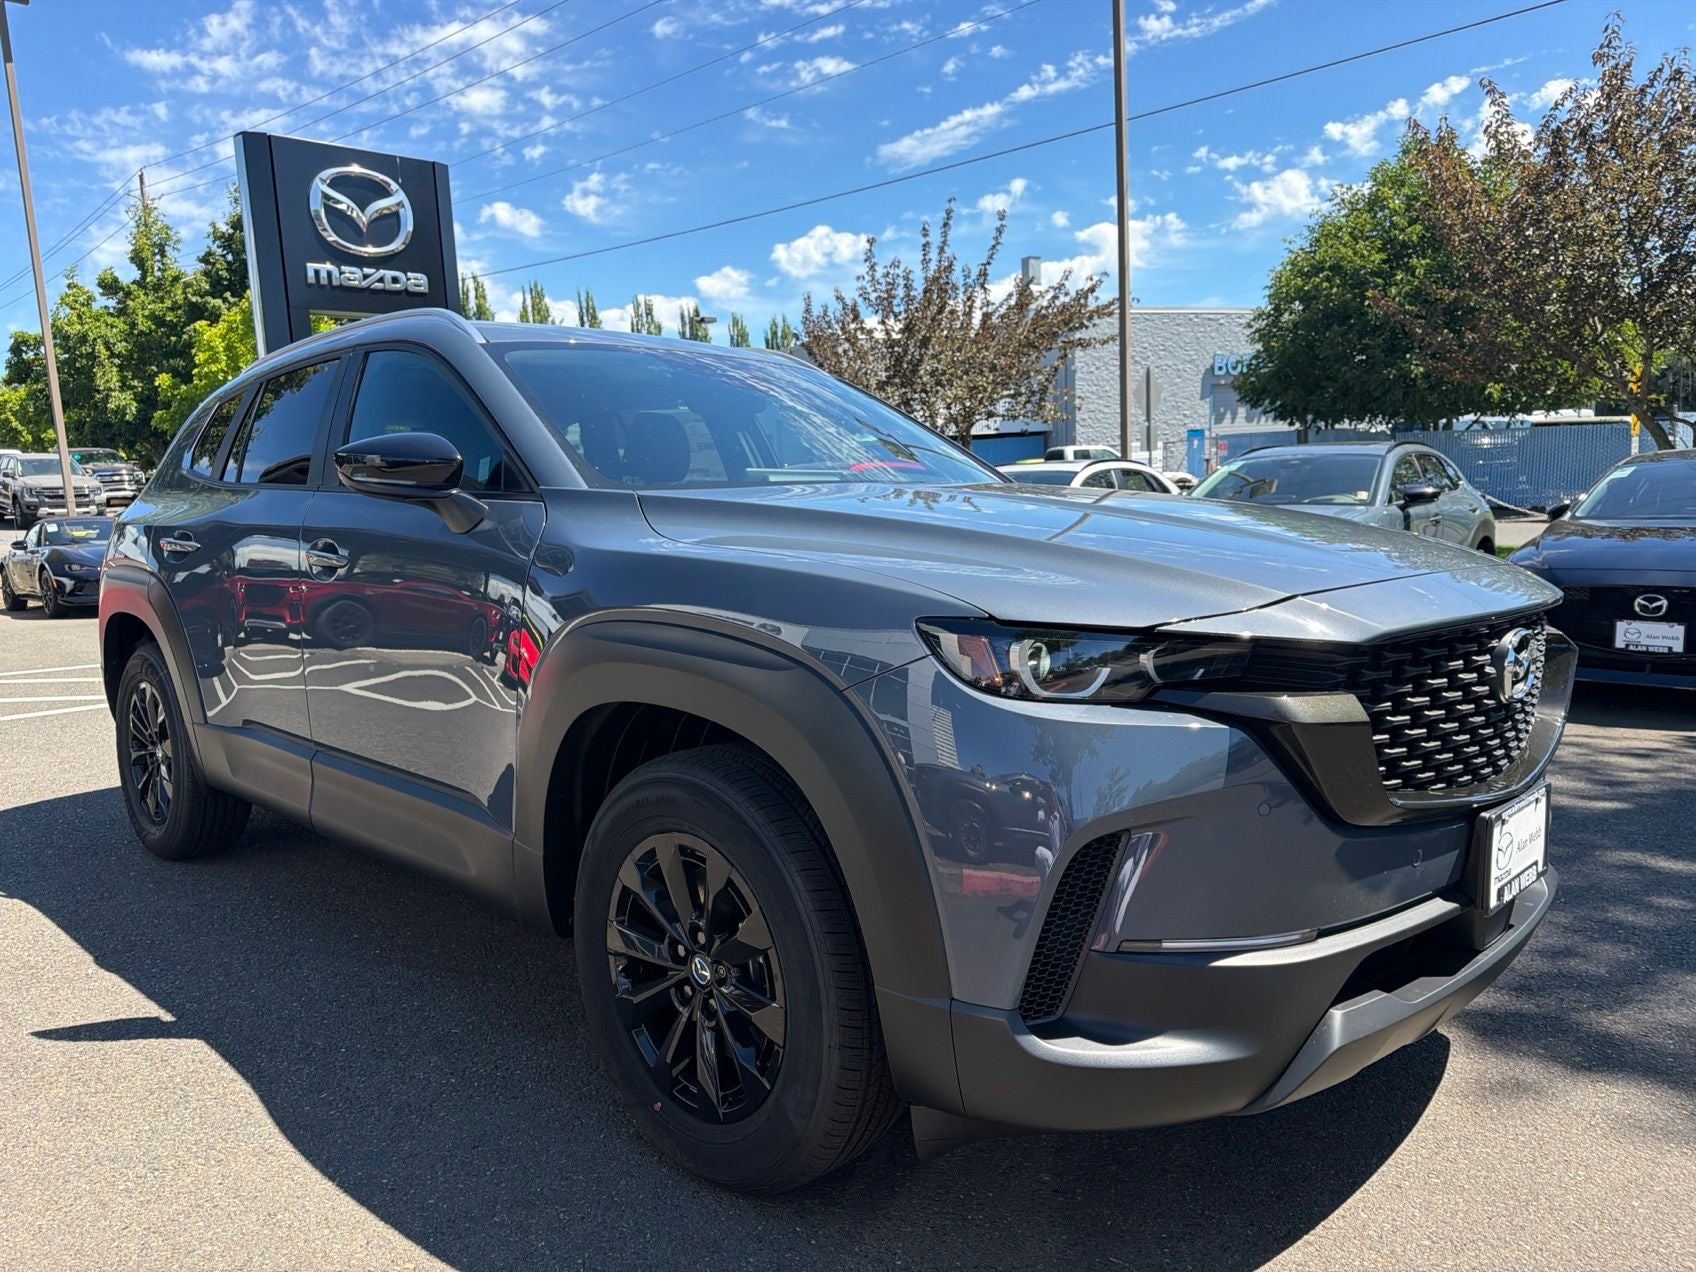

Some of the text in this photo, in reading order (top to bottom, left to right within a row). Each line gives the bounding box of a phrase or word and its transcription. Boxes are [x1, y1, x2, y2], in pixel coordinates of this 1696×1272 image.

[1515, 827, 1542, 855] Alan Webb
[1503, 864, 1537, 904] ALAN WEBB
